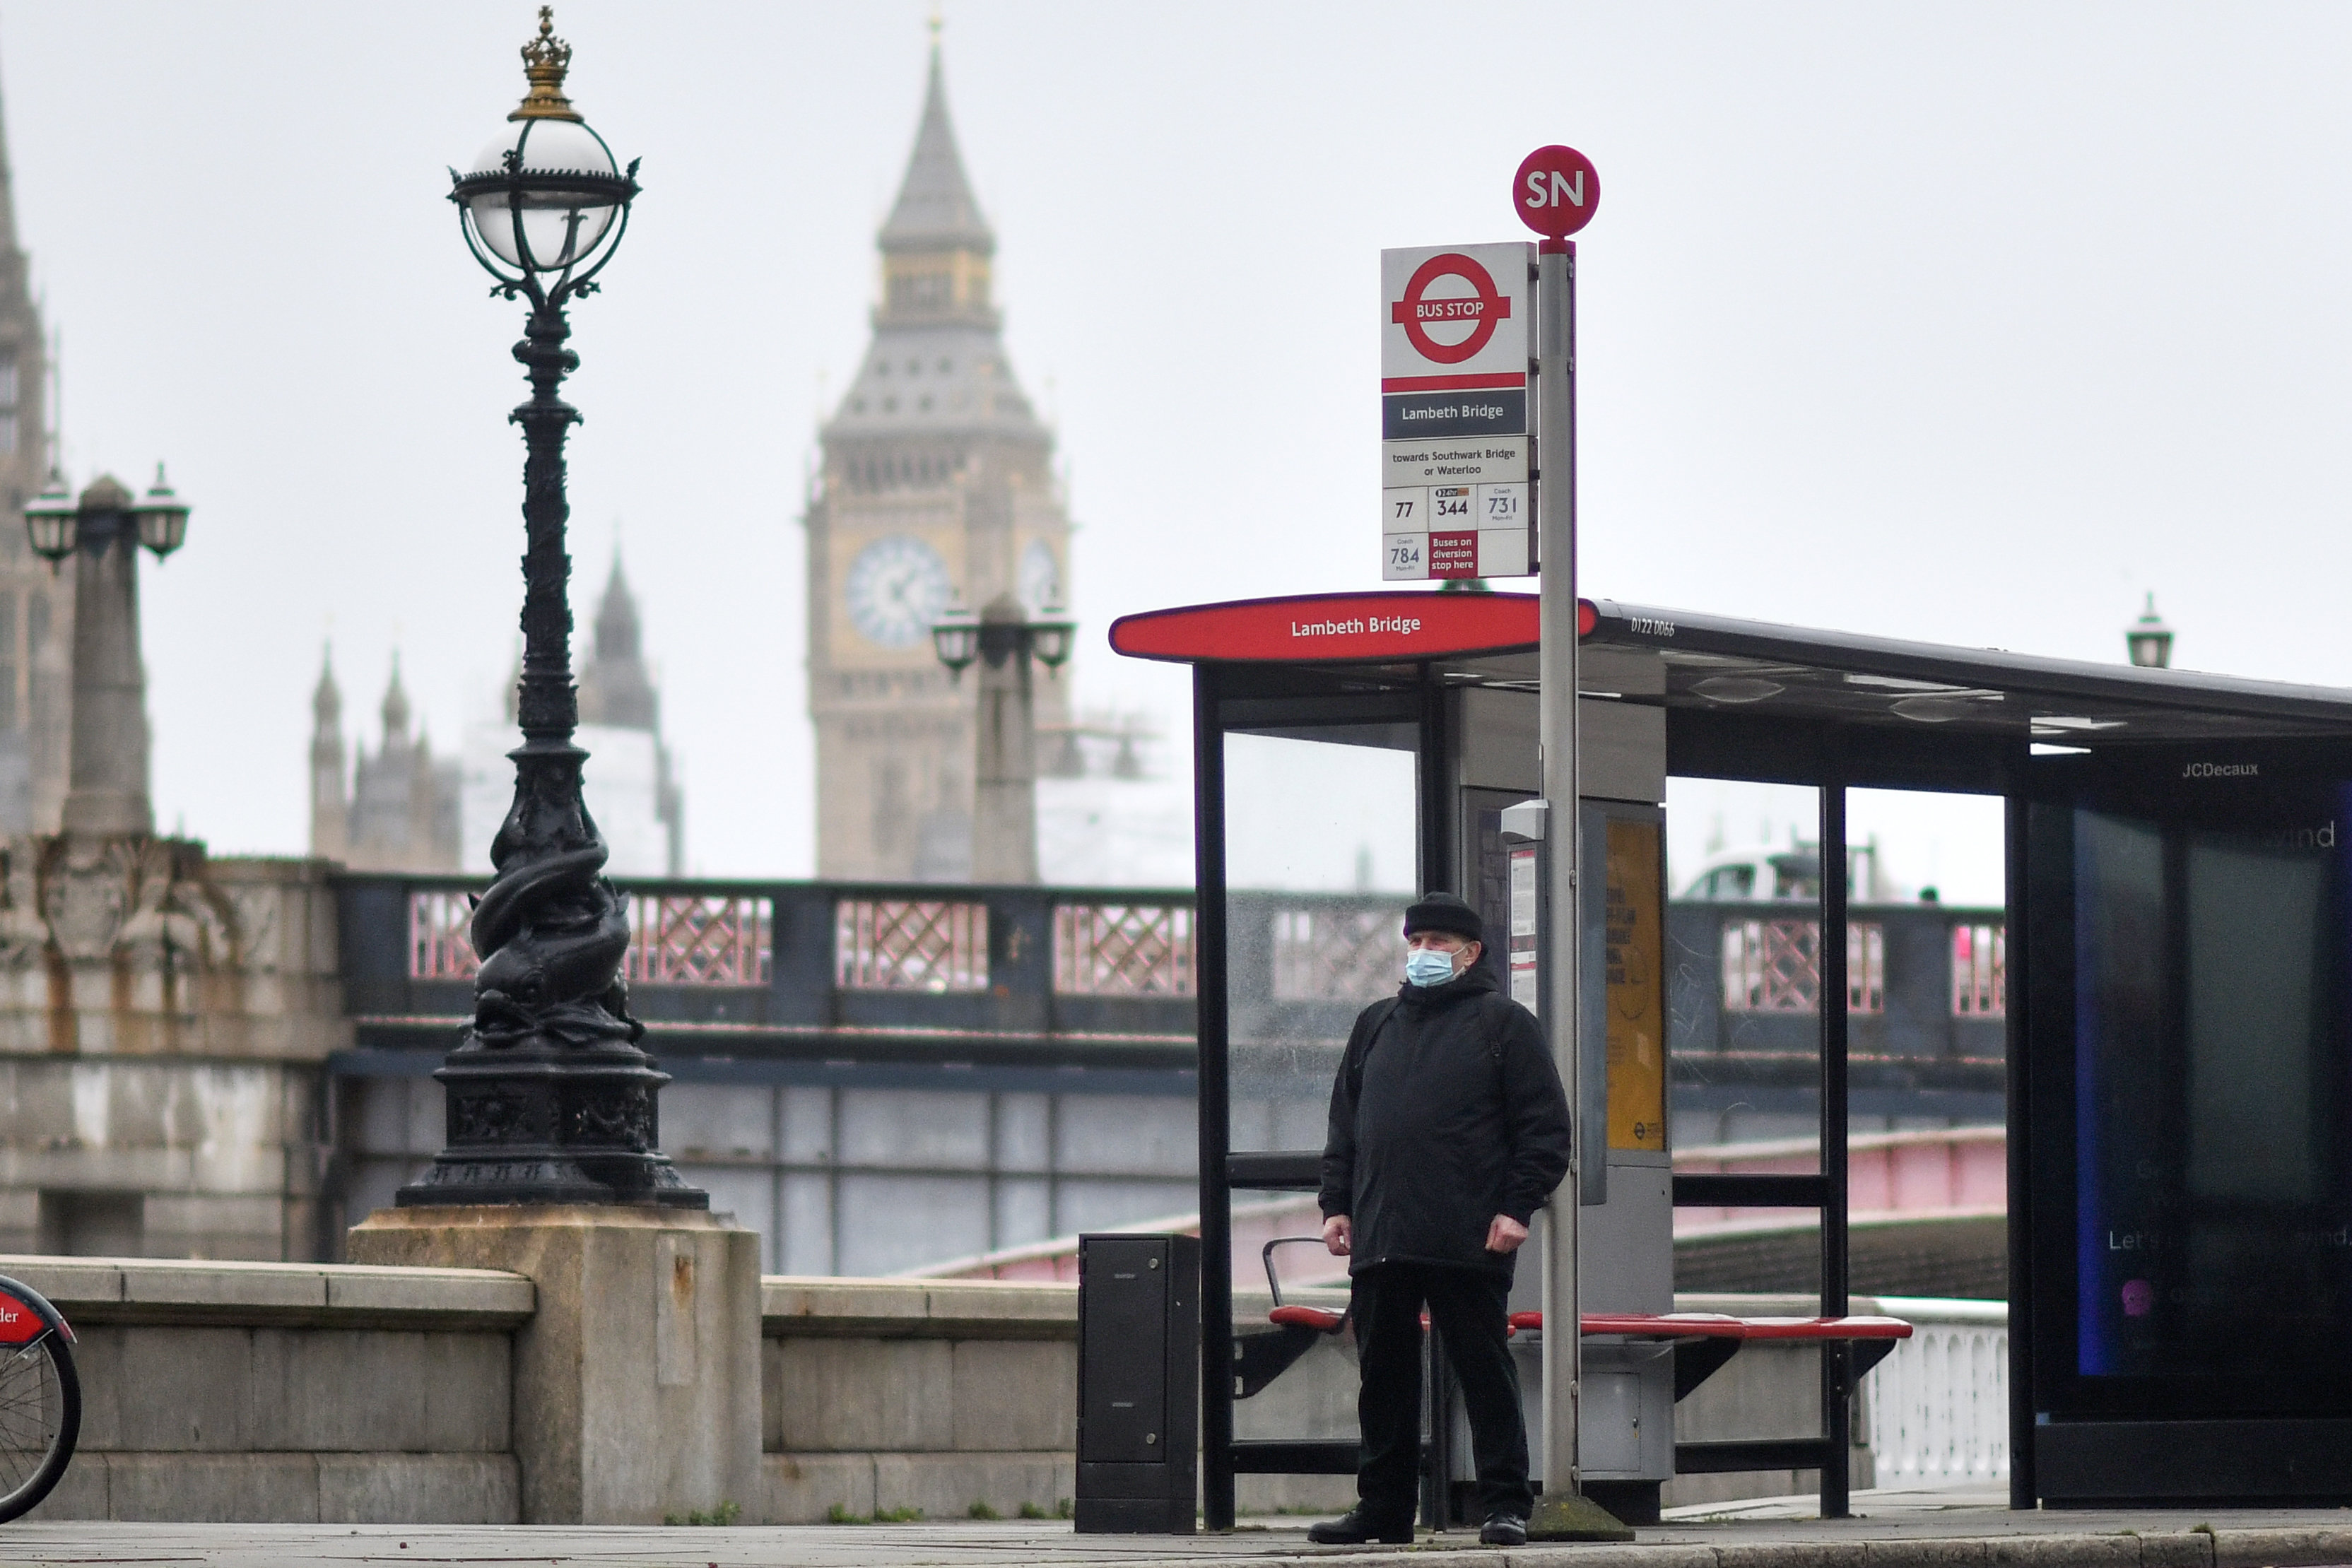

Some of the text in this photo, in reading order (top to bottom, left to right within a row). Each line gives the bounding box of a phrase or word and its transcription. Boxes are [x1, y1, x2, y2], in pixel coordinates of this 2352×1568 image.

[1525, 170, 1584, 208] SN
[1416, 302, 1484, 317] BUS STOP
[1401, 404, 1504, 420] Lambeth Bridge
[1392, 449, 1515, 462] towards Southwark Bridge
[1437, 465, 1481, 475] Waterloo
[1395, 501, 1414, 519] 77
[1437, 499, 1469, 516] 344
[1488, 497, 1517, 514] 731
[1433, 538, 1458, 547] Buses
[1390, 548, 1420, 565] 784
[1433, 549, 1473, 558] diversion
[1431, 560, 1474, 571] stop here
[1291, 615, 1421, 636] Lambeth Bridge
[1631, 616, 1675, 637] 0122 0066
[2182, 762, 2259, 777] JCDecaux
